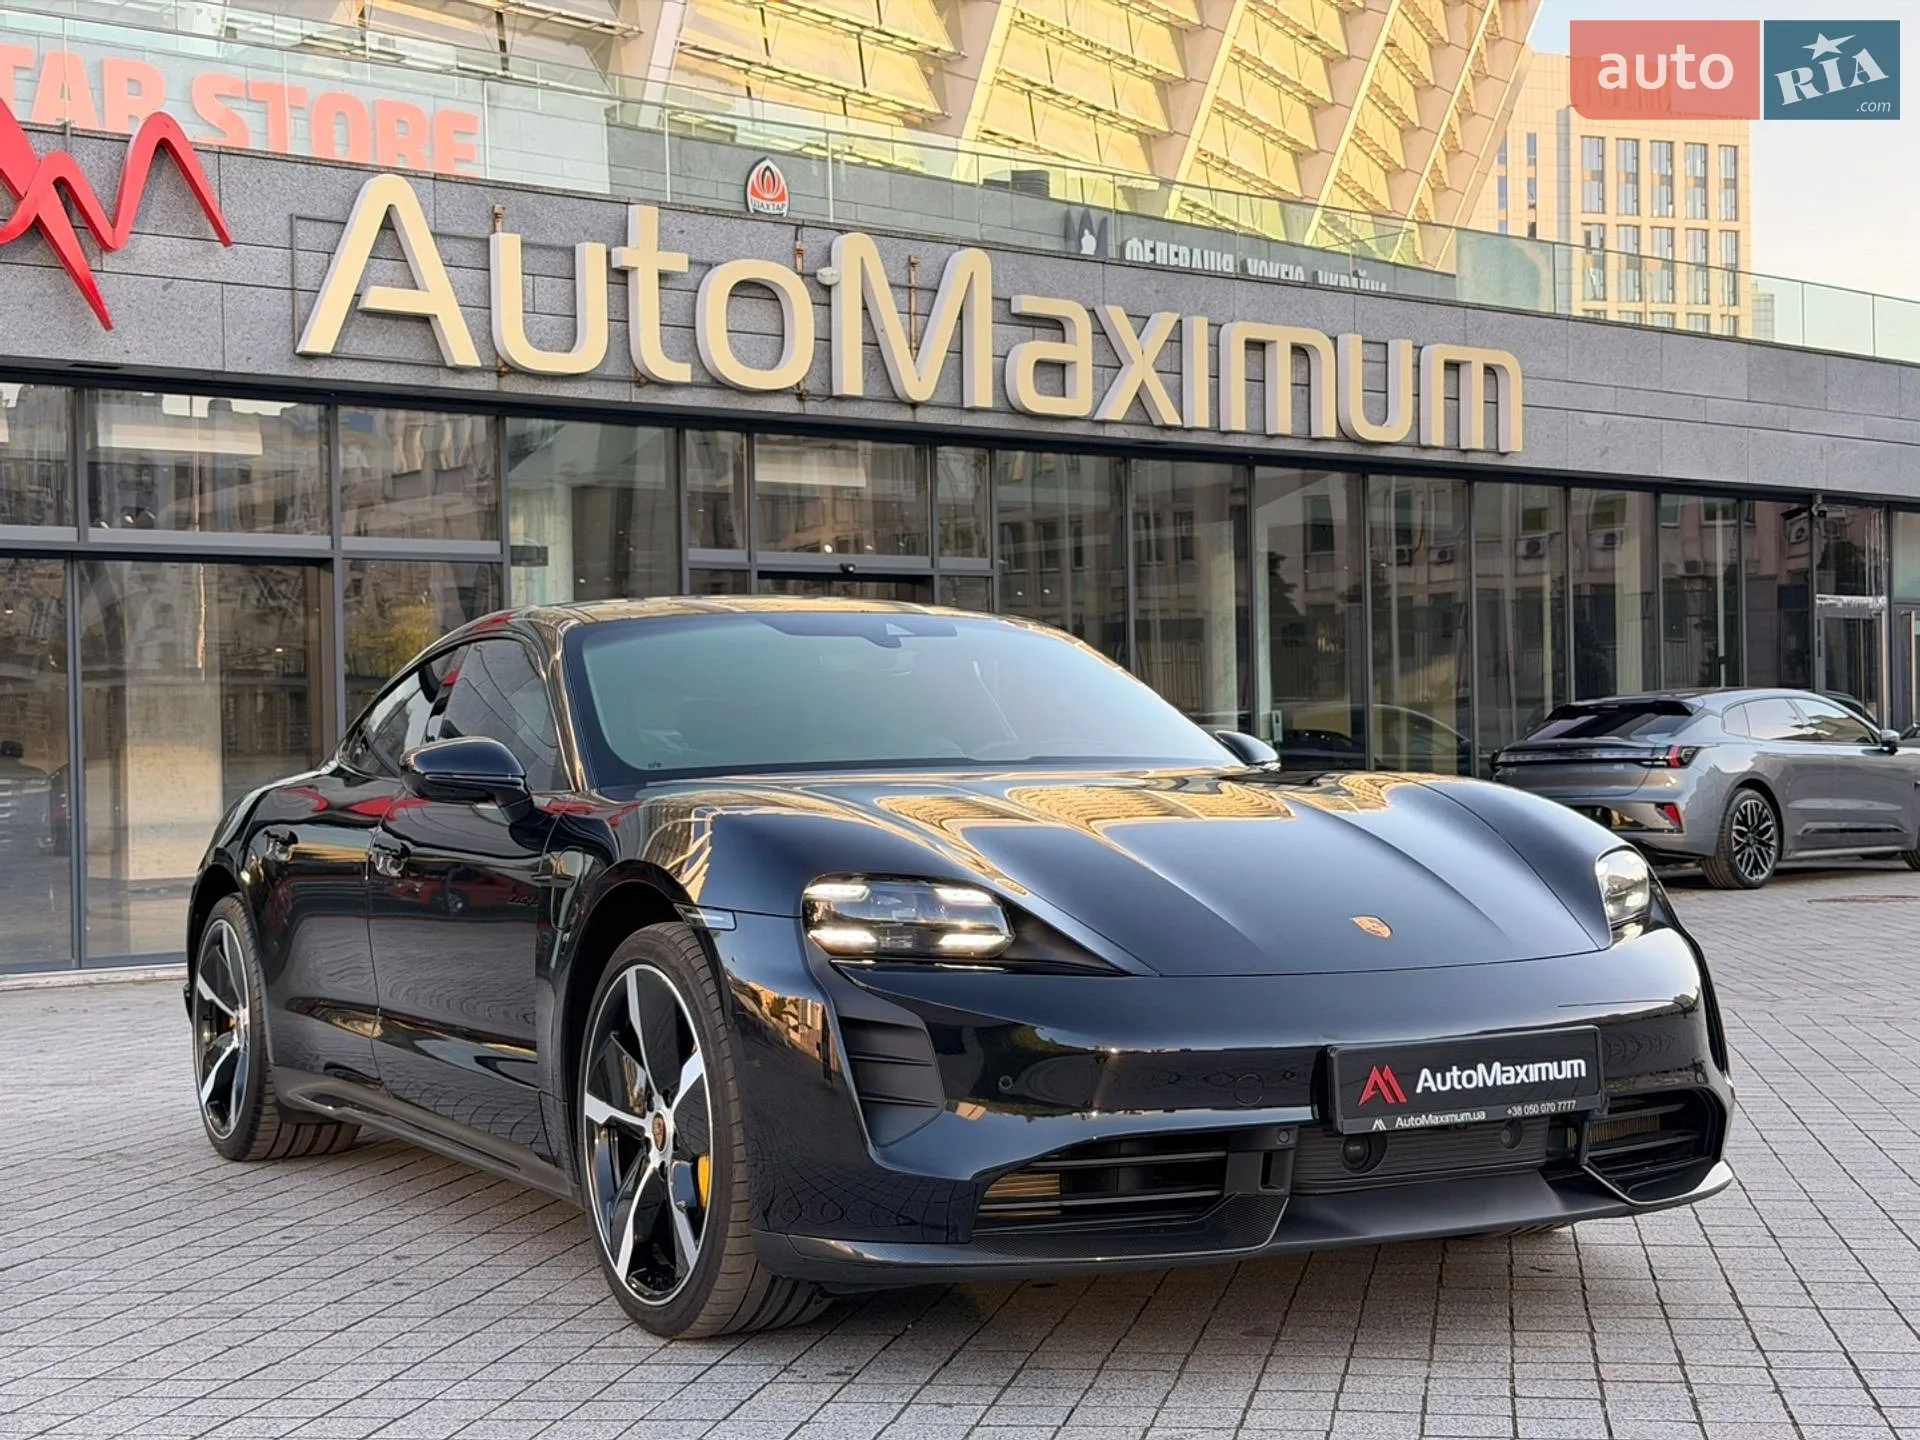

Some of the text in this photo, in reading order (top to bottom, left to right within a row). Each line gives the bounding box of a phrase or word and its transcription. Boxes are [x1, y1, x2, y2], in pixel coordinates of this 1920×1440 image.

[192, 71, 480, 178] STORE
[296, 173, 1524, 454] AutoMaximum
[1416, 1058, 1587, 1094] AutoMaximum
[1395, 1110, 1486, 1129] AutoMaximum.ua
[1507, 1100, 1577, 1117] +38 050 070 7777
